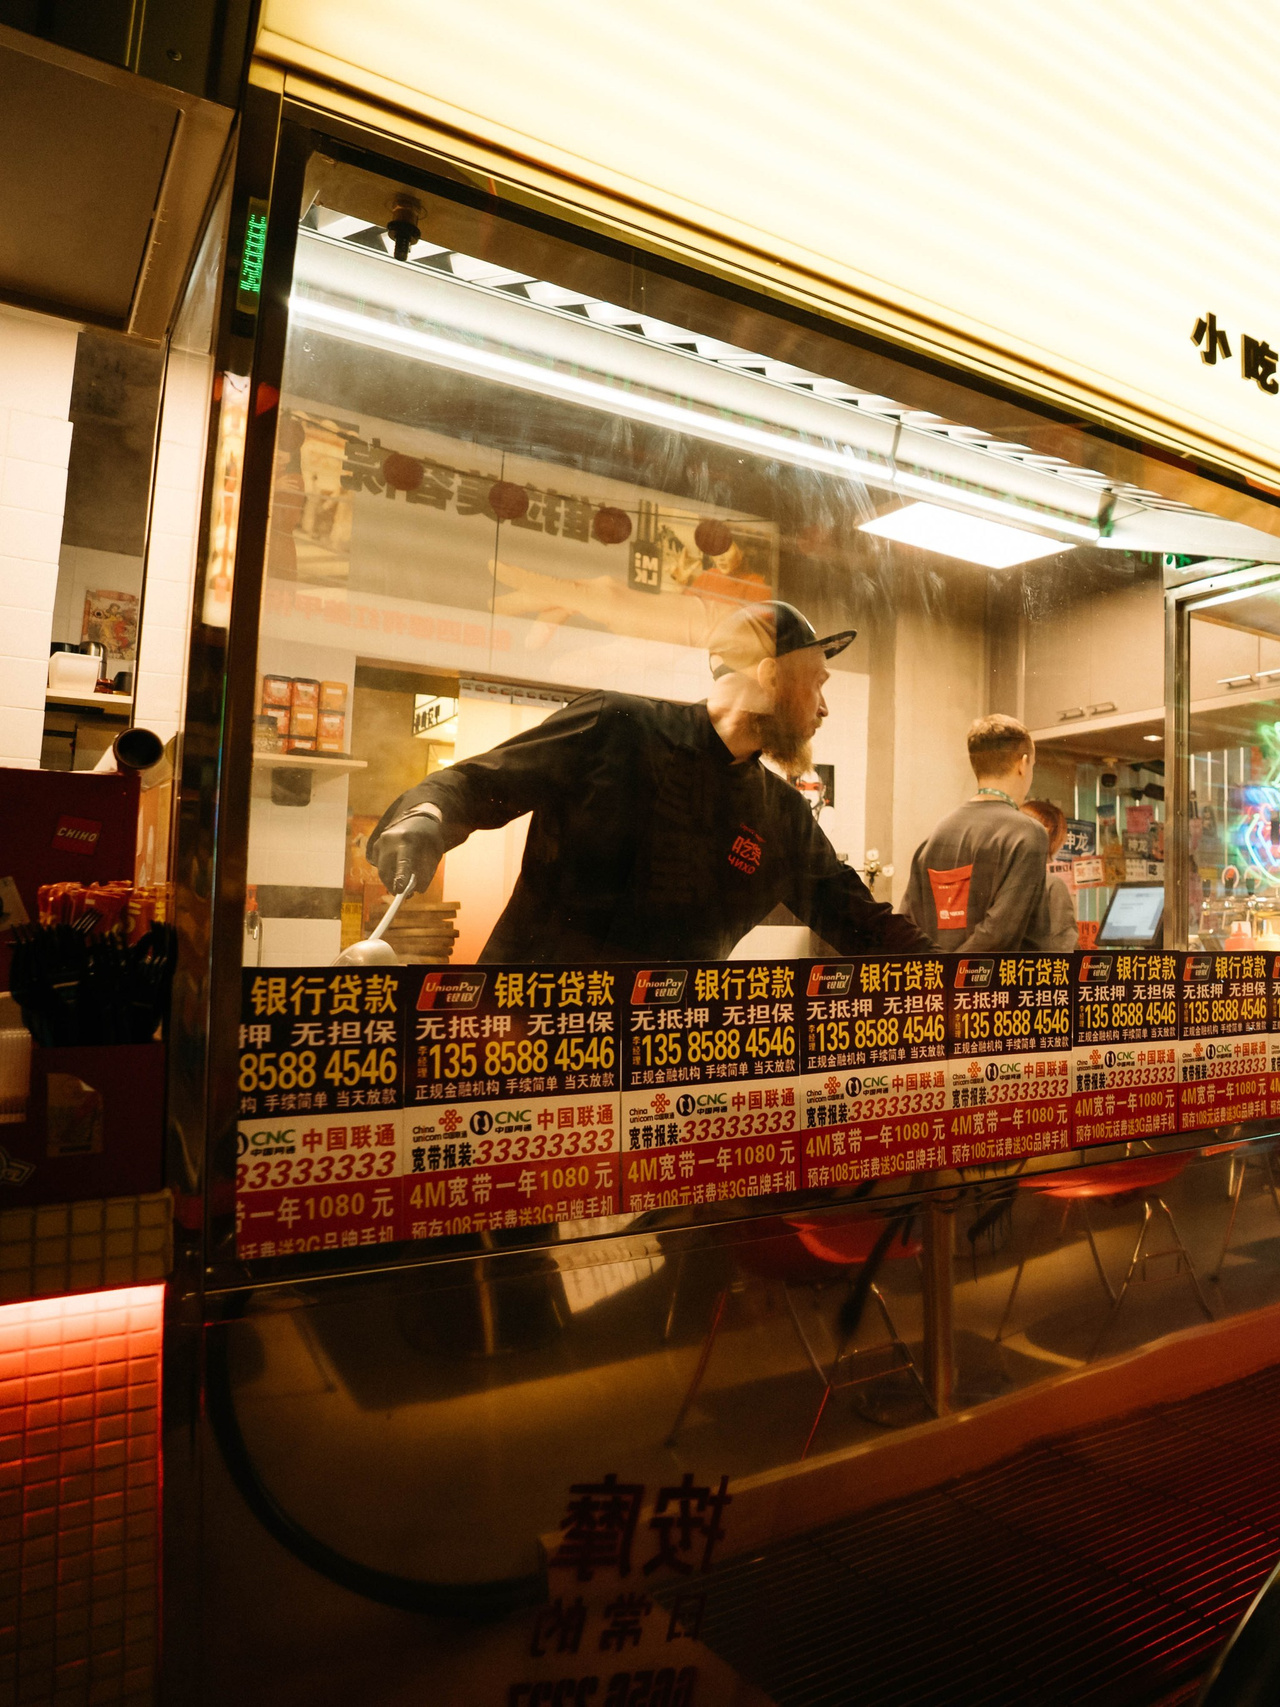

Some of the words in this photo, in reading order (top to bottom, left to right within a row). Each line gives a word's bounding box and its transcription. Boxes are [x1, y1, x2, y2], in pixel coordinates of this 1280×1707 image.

[812, 972, 850, 982] UnionPay
[860, 960, 944, 993] 银行贷款
[999, 959, 1069, 986] 银行贷款
[1116, 956, 1176, 980] 银行贷款
[1216, 956, 1267, 979] 银行贷款
[251, 974, 398, 1016] 银行贷款
[425, 982, 480, 994] UnionPay
[494, 971, 615, 1008] 银行贷款
[638, 978, 683, 989] UnionPay
[695, 966, 794, 1002] 银行贷款
[1078, 986, 1125, 1001] 无抵押
[1133, 984, 1176, 1000] 无担保
[1184, 984, 1223, 999] 无抵押
[1230, 982, 1267, 997] 无担保
[807, 999, 872, 1020] 无抵押
[883, 994, 944, 1015] 无担保
[954, 992, 1009, 1009] 无抵押
[1018, 990, 1069, 1007] 无担保
[1189, 1001, 1209, 1024] 135
[1212, 999, 1239, 1022] 8588
[1241, 998, 1267, 1020] 4546
[416, 1016, 512, 1040] 无抵押
[527, 1012, 614, 1035] 无担保
[631, 1008, 709, 1031] 无抵押
[722, 1003, 794, 1026] 无担保
[961, 1012, 989, 1039] 135
[993, 1010, 1030, 1037] 8588
[1034, 1008, 1069, 1034] 4546
[1084, 1004, 1108, 1028] 135
[1111, 1002, 1143, 1027] 8588
[1146, 1001, 1176, 1025] 4546
[291, 1020, 397, 1048] 无担保
[642, 1033, 681, 1066] 135
[688, 1029, 740, 1062] 8588
[745, 1026, 795, 1058] 4546
[816, 1021, 850, 1052] 135
[854, 1018, 898, 1048] 8588
[903, 1014, 945, 1044] 4546
[239, 1051, 316, 1092] 8588
[324, 1047, 397, 1086] 4546
[429, 1043, 477, 1079] 135
[485, 1039, 548, 1076] 8588
[554, 1036, 614, 1071] 4546
[807, 1051, 865, 1069] 正规金融机构
[869, 1047, 906, 1063] 手续简单
[910, 1045, 945, 1059] 当天放款
[1024, 1060, 1068, 1078] 中国联通
[1137, 1049, 1175, 1065] 中国联通
[631, 1066, 700, 1085] 正规金融机构
[705, 1062, 748, 1079] 手续简单
[754, 1059, 795, 1075] 当天放款
[863, 1076, 888, 1088] CNC
[892, 1071, 945, 1092] 中国联通
[415, 1080, 500, 1100] 正规金融机构
[506, 1076, 558, 1094] 手续简单
[564, 1073, 614, 1090] 当天放款
[697, 1093, 727, 1106] CNC
[732, 1088, 795, 1111] 中国联通
[265, 1093, 328, 1113] 手续简单
[336, 1087, 397, 1108] 当天放款
[495, 1110, 532, 1124] CNC
[537, 1105, 614, 1130] 中国联通
[250, 1129, 296, 1146] CNC
[302, 1123, 396, 1154] 中国联通
